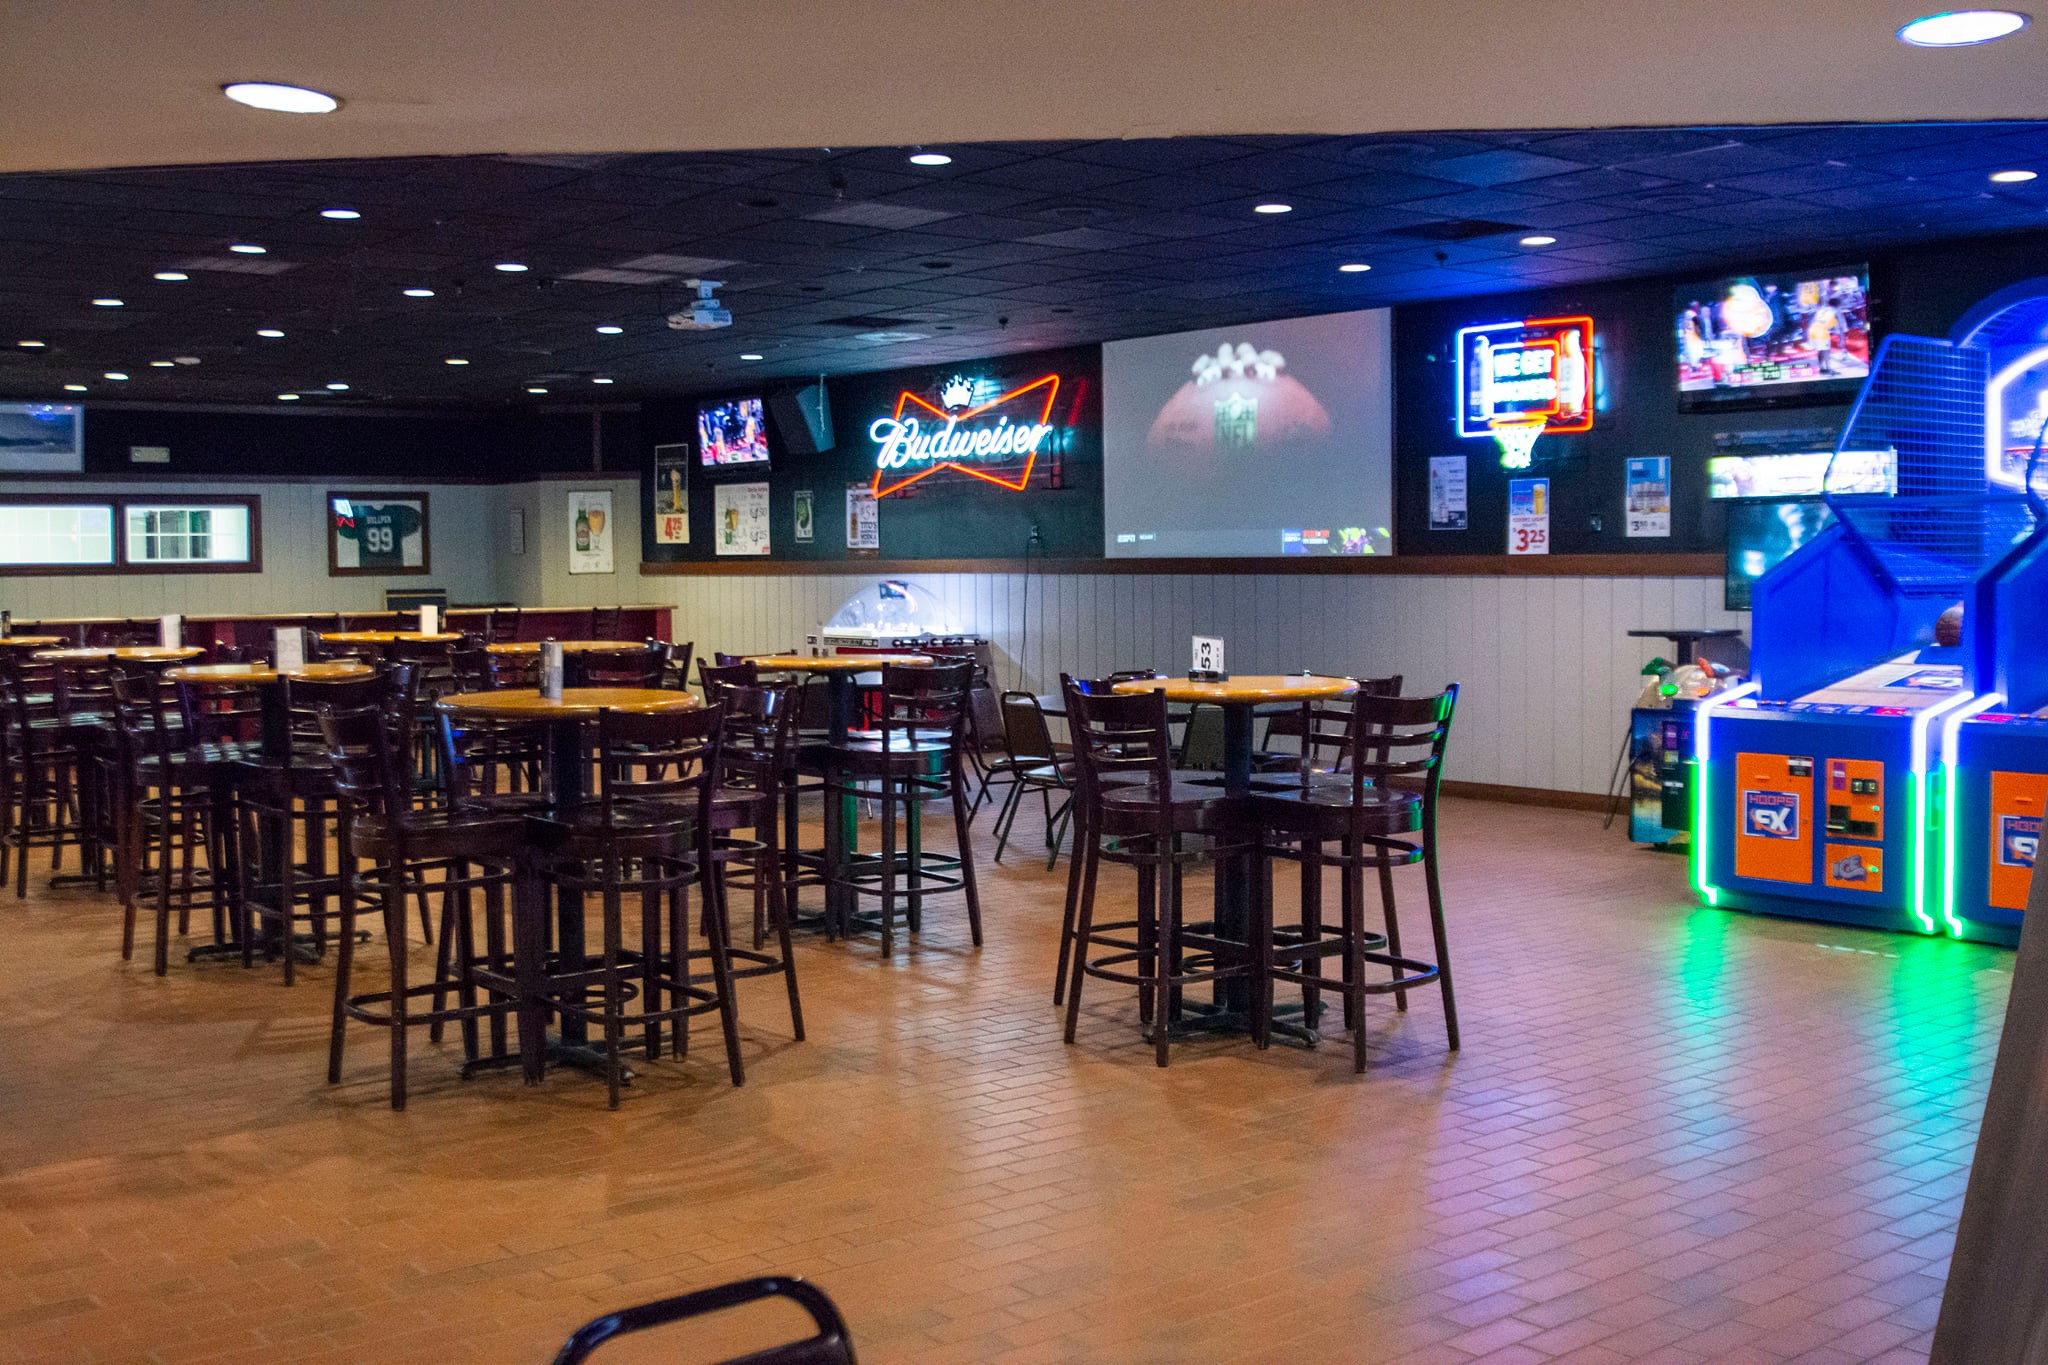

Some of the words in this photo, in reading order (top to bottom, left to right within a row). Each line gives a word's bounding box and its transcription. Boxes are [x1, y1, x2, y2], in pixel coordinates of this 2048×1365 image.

[870, 415, 1053, 468] Budweiser
[367, 527, 393, 553] 99
[1201, 642, 1212, 670] 53
[1749, 794, 1796, 808] HOOPS
[1832, 854, 1868, 882] ICE
